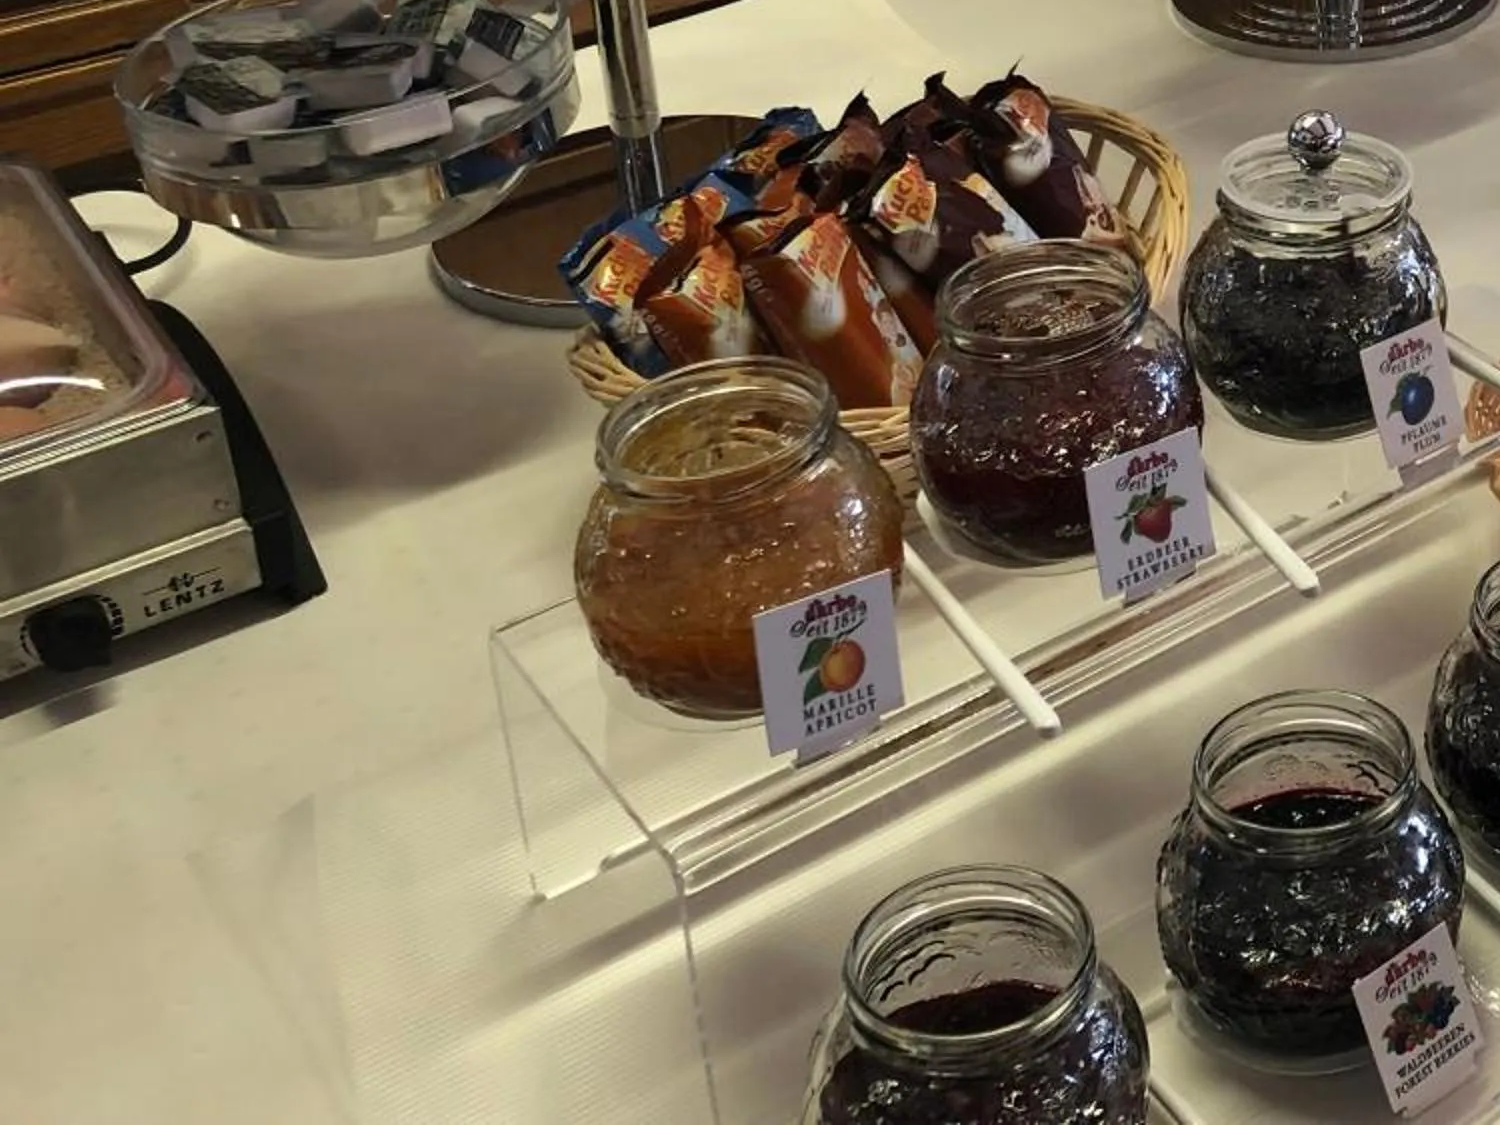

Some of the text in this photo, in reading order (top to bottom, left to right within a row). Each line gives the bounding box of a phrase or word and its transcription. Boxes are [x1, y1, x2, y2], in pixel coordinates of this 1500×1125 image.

[1117, 545, 1204, 590] STRAWBERRY
[1127, 536, 1190, 571] ERDBEER
[143, 578, 225, 618] LENTZ
[803, 684, 876, 721] MARILLE
[805, 699, 877, 736] APRICOT
[1395, 1032, 1476, 1098] FOREST BERRIES
[1397, 1023, 1466, 1078] WALDBEEREN
